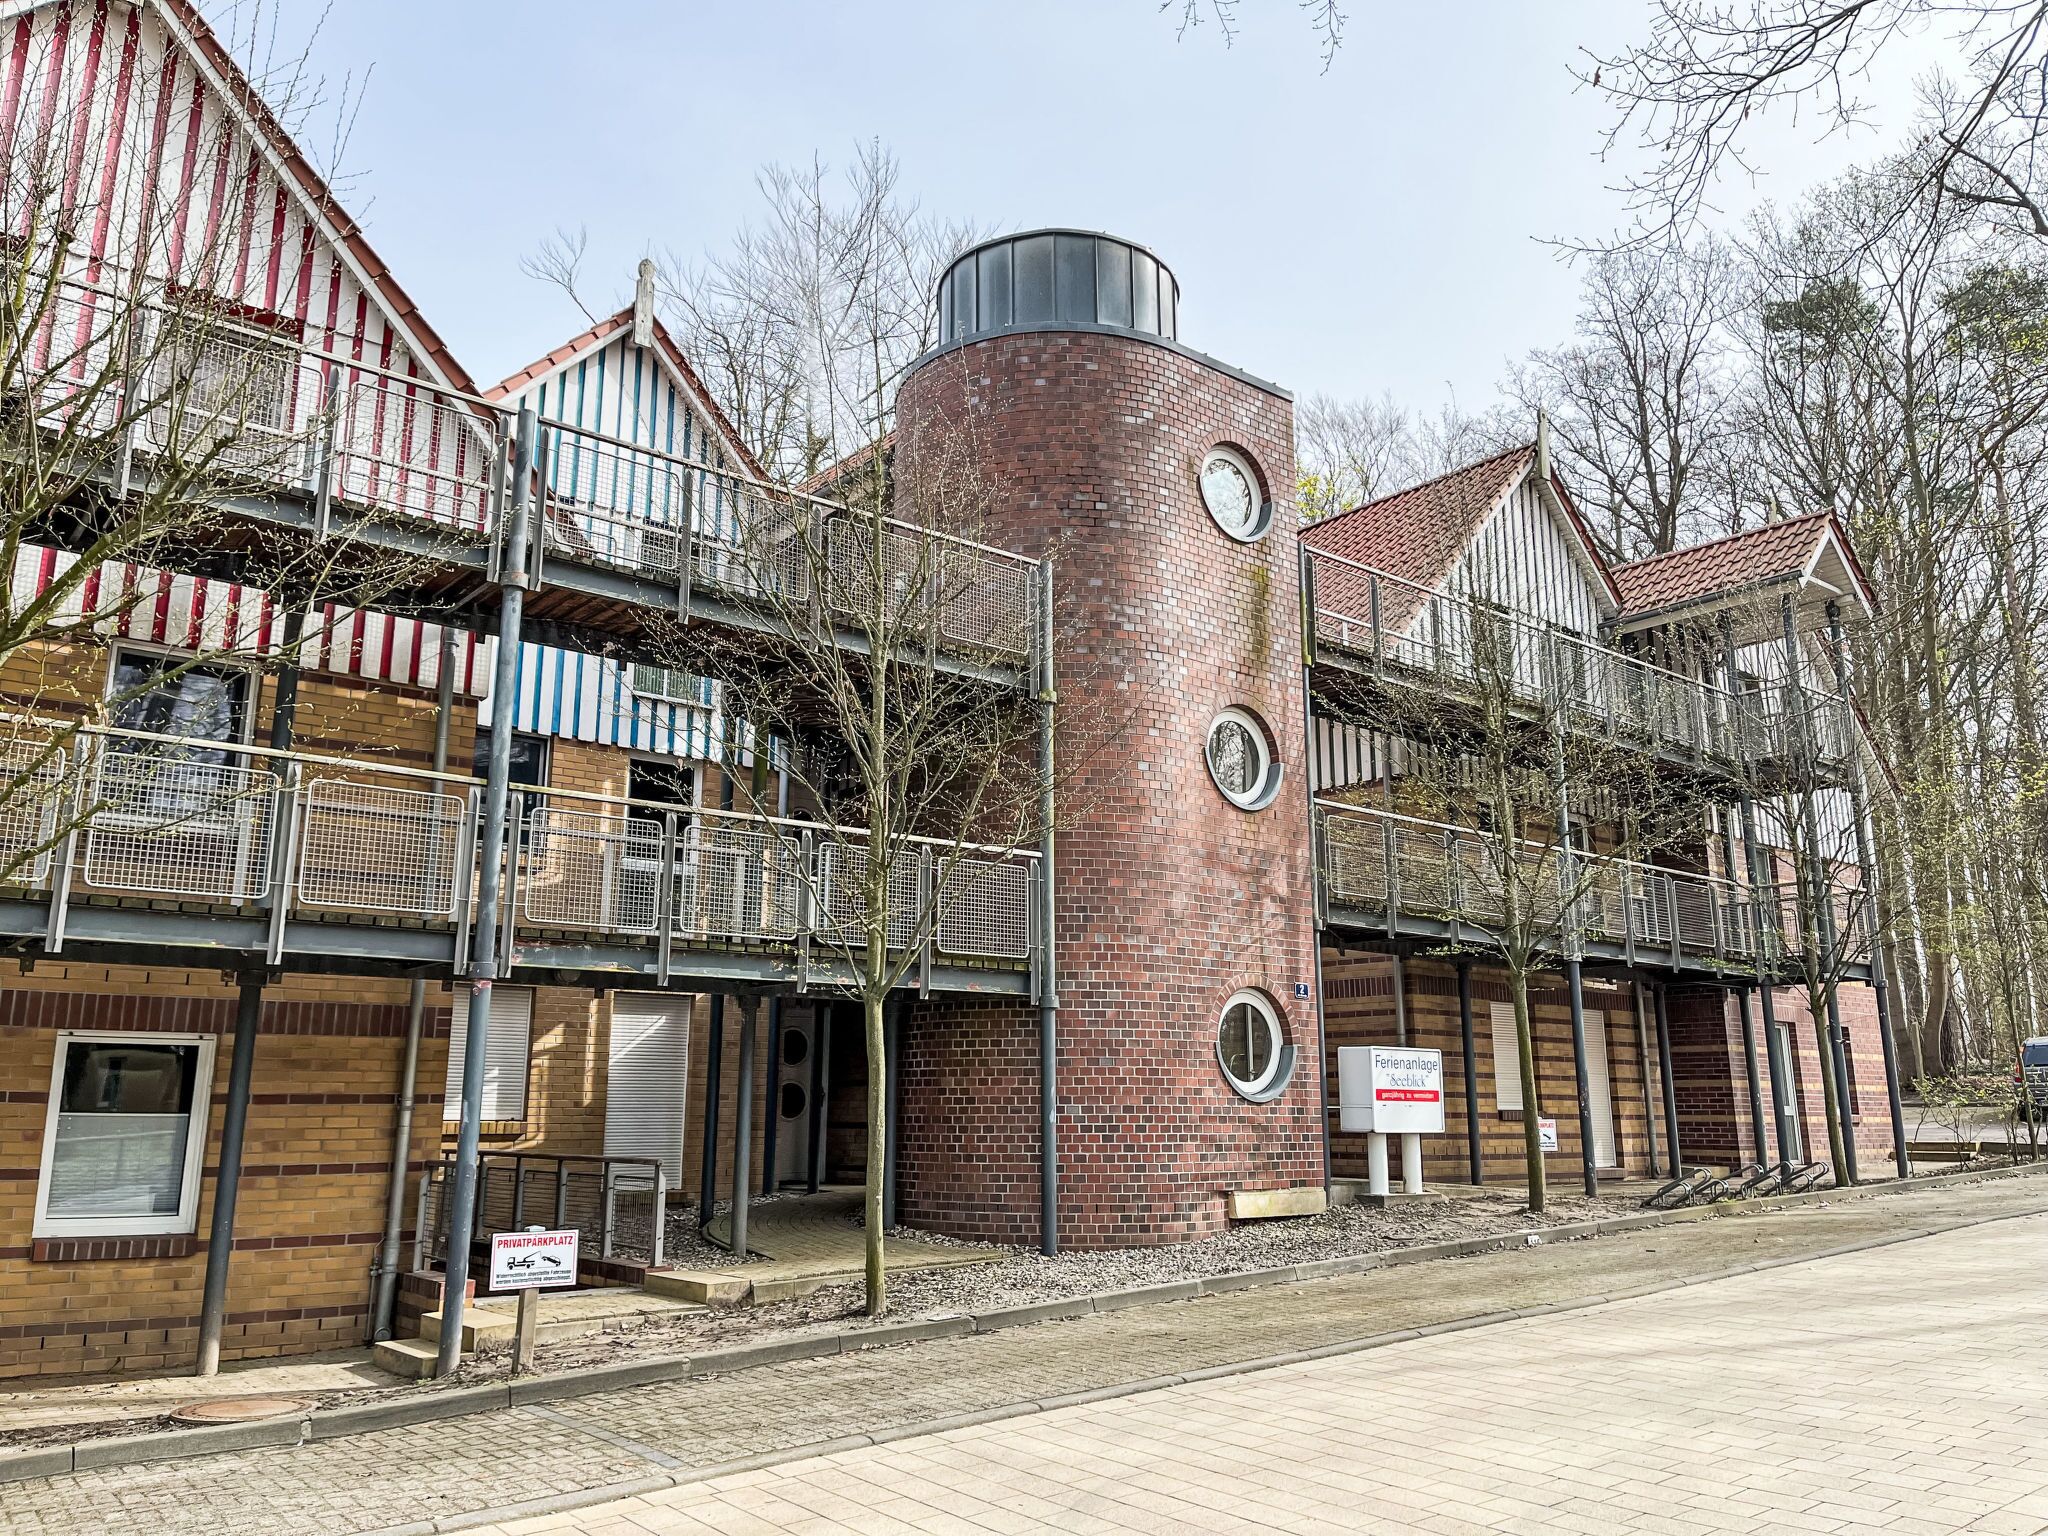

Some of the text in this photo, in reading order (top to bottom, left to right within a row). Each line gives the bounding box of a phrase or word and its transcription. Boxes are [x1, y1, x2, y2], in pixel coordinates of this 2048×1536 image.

[1299, 984, 1305, 994] 2
[1375, 1054, 1438, 1074] Ferienanlage
[497, 1236, 573, 1249] PRIVATPARKPLATZ
